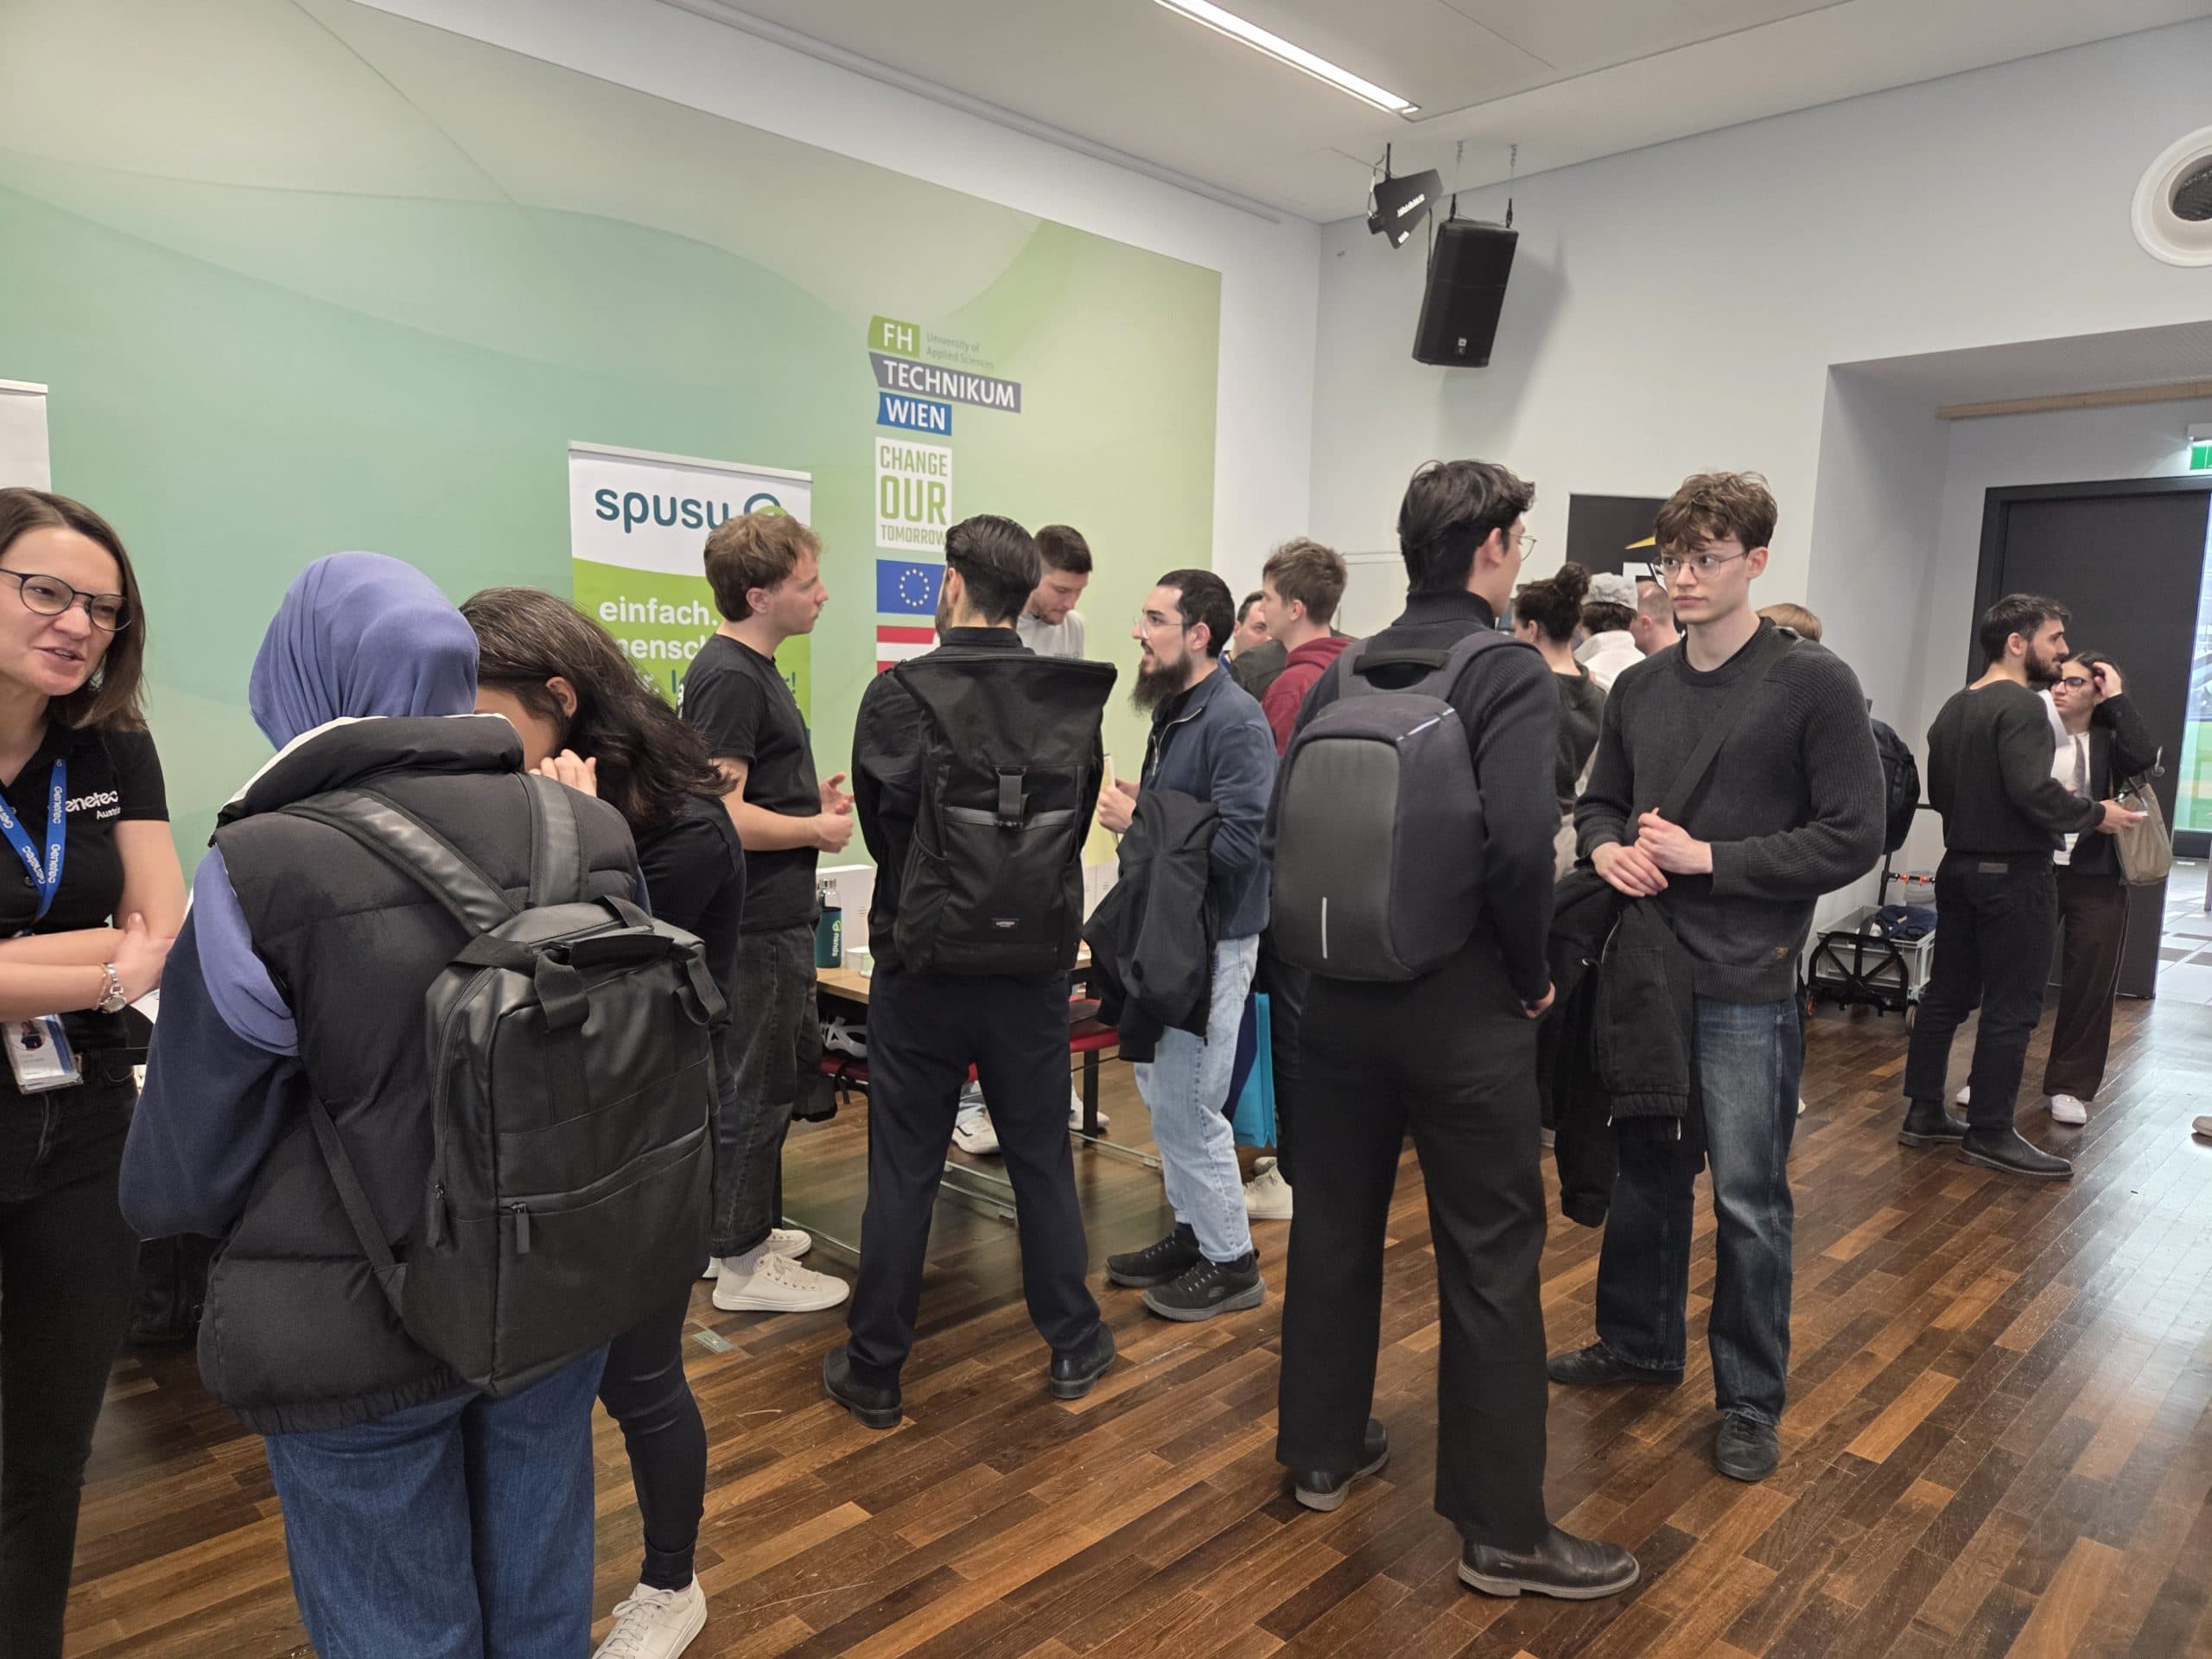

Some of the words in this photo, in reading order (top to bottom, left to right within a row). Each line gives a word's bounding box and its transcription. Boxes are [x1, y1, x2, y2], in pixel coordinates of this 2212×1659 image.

[883, 323, 912, 352] FH
[926, 333, 970, 353] University
[883, 360, 1015, 409] TECHNIKUM
[886, 397, 945, 430] WIEN
[880, 445, 948, 477] CHANGE
[594, 488, 729, 534] spusu
[880, 475, 947, 526] OUR
[880, 524, 946, 546] TOMORROW
[599, 596, 718, 626] einfach.
[65, 790, 118, 813] enetec
[48, 843, 61, 884] Genetec
